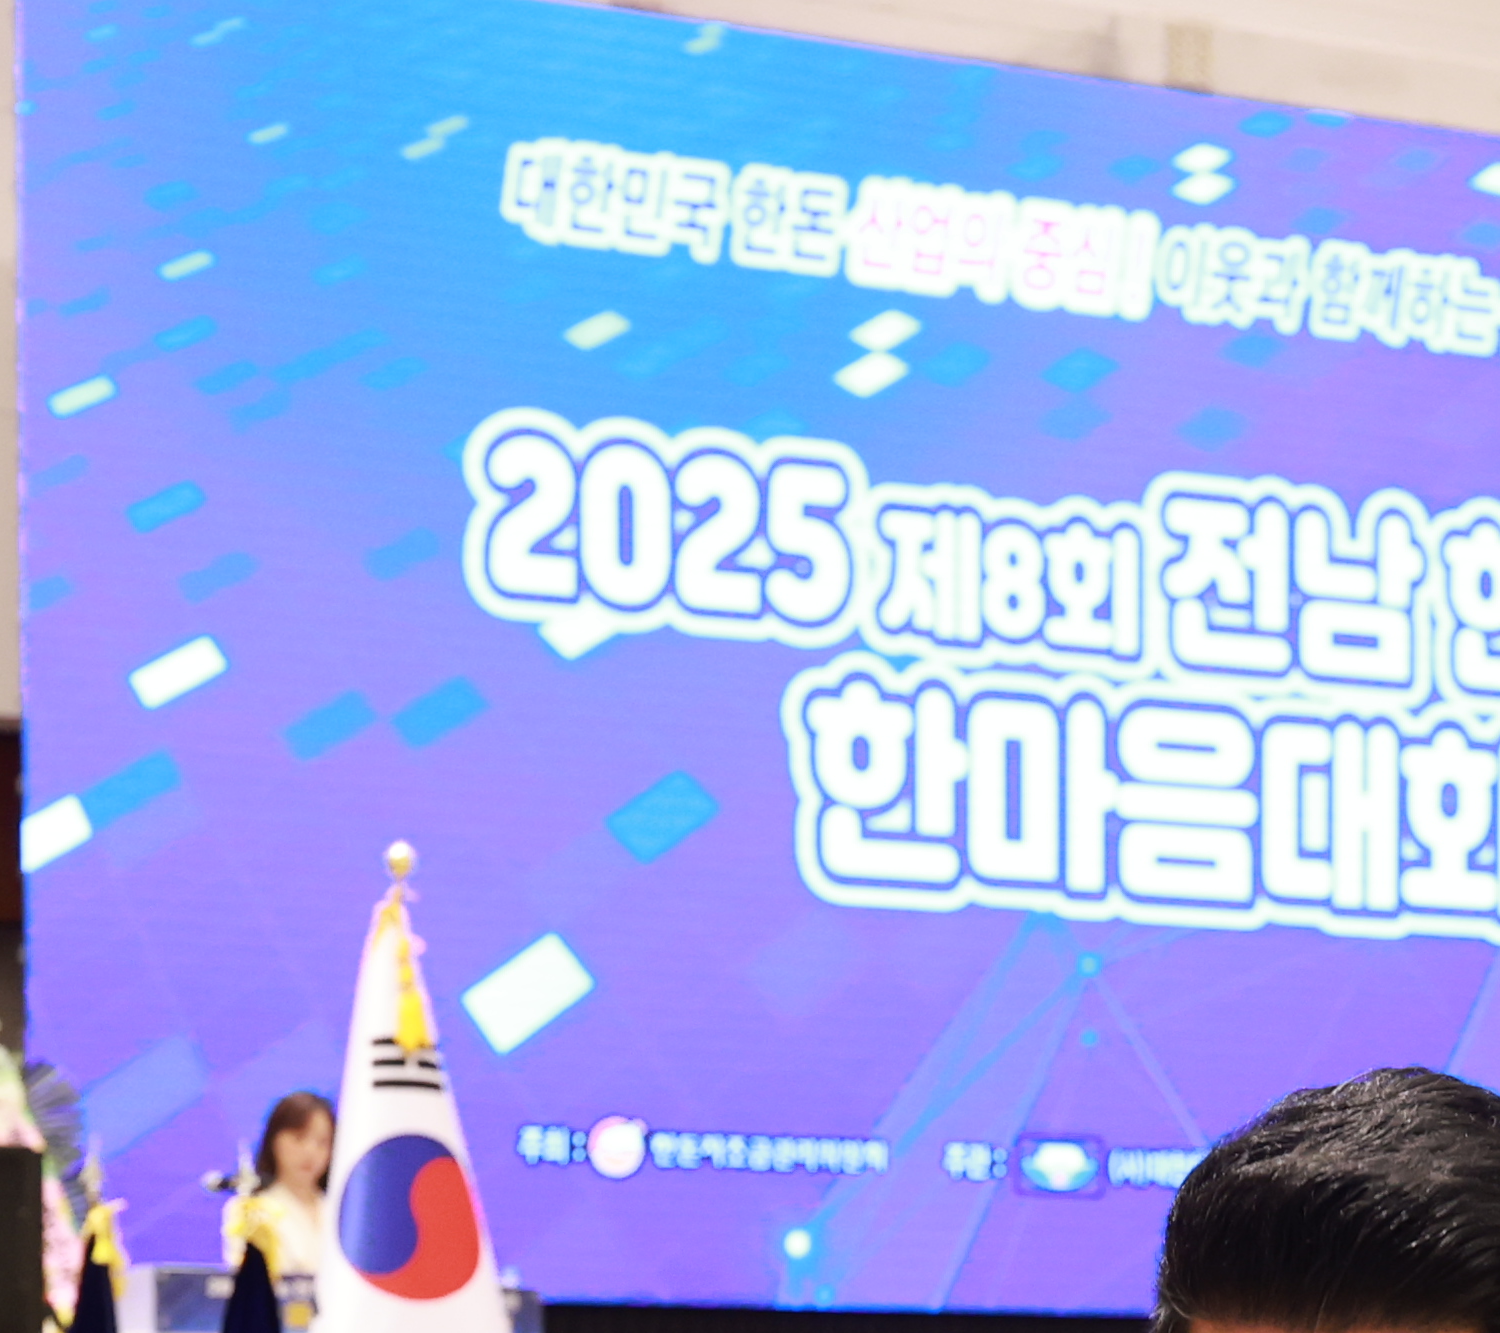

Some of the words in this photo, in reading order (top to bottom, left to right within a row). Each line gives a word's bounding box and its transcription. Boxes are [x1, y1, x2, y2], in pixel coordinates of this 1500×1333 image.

[500, 137, 731, 264] 대한민국
[730, 161, 849, 278] 한돈
[1153, 222, 1304, 335] 이웃과
[1305, 236, 1500, 357] 함께하는
[468, 413, 865, 638] 2025
[868, 492, 1150, 668] 제8회
[1150, 482, 1434, 698] 전남
